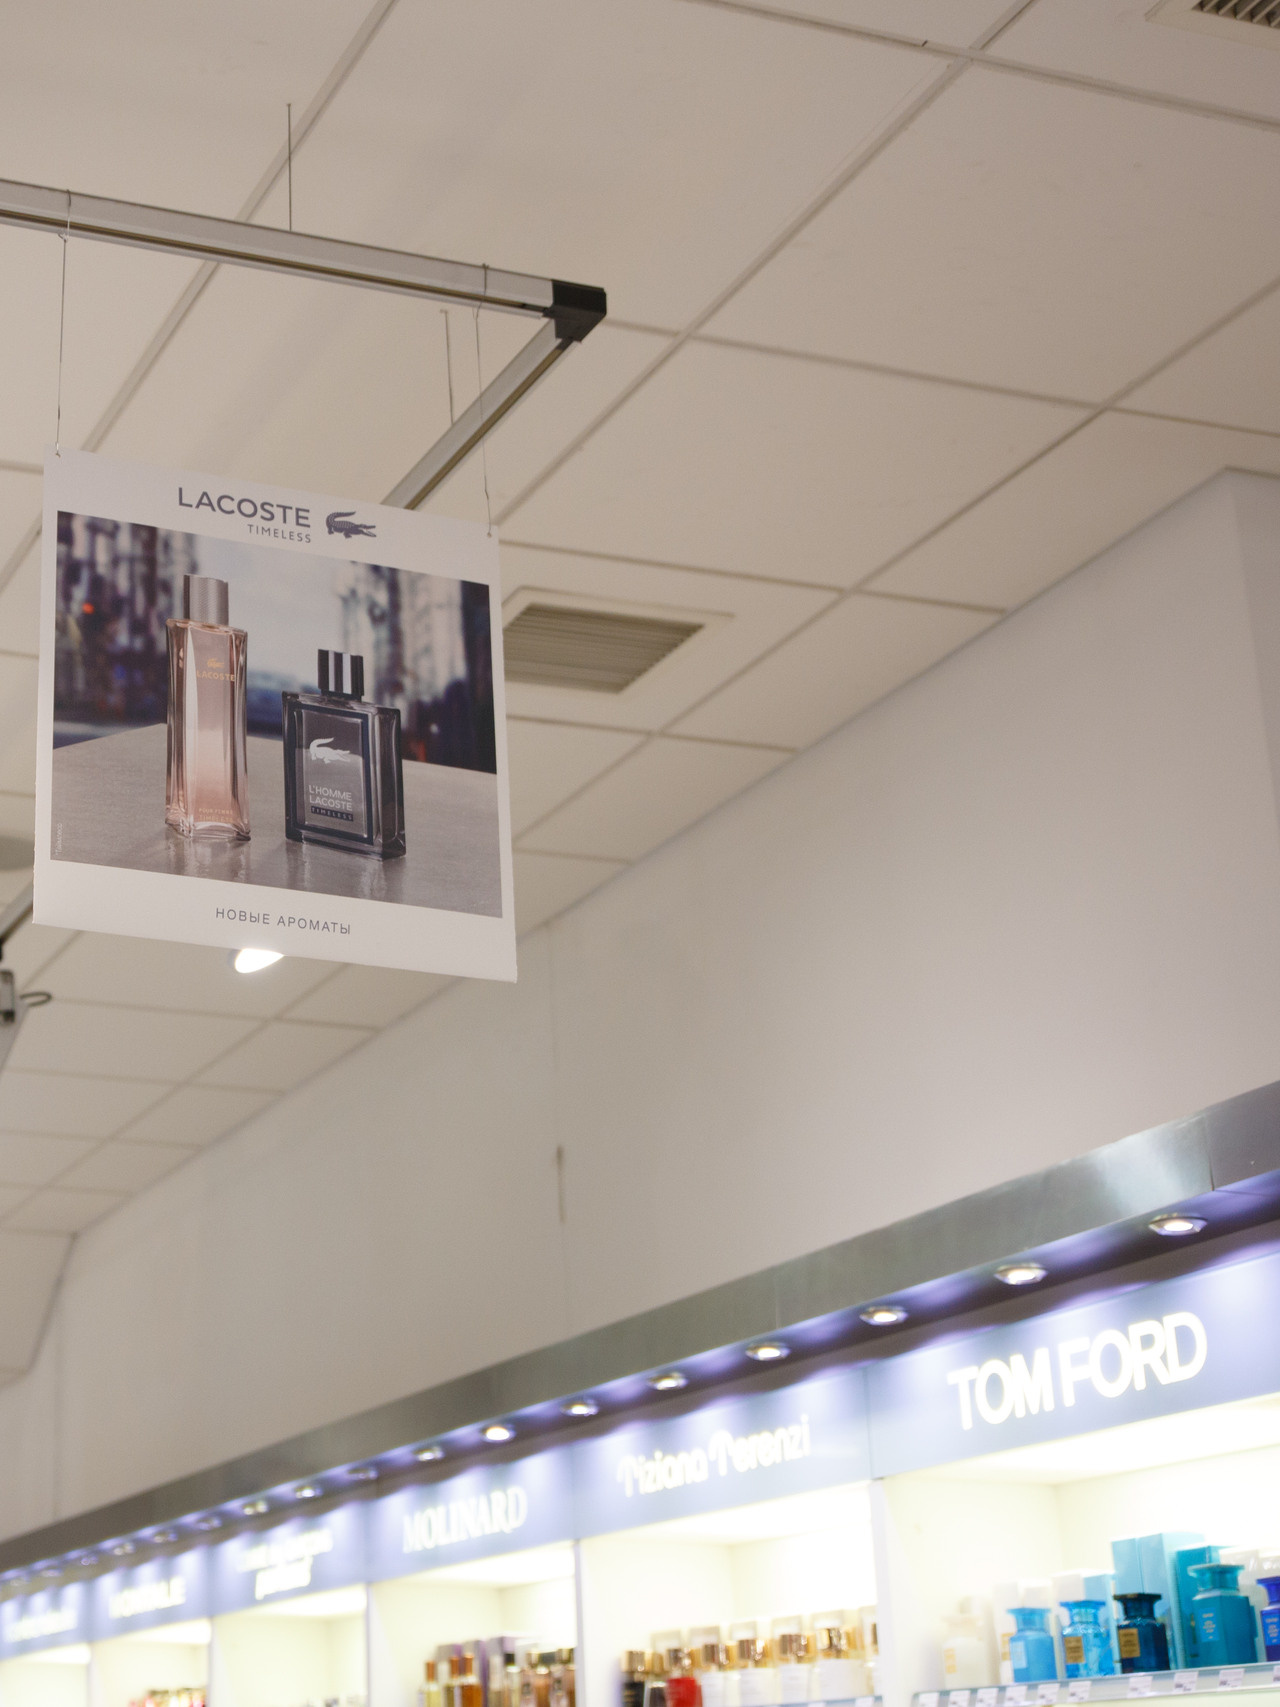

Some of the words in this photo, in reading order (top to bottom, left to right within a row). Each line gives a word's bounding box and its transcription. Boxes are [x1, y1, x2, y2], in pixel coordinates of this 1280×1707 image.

[178, 487, 311, 528] LACOSTE
[247, 523, 311, 544] TIMELESS
[196, 669, 235, 682] LACOSTE
[308, 784, 353, 801] L'HOMME
[309, 795, 353, 812] LACOSTE
[311, 806, 353, 821] TIMELESS
[215, 907, 270, 925] НОВЫЕ
[276, 915, 351, 935] АРОМАТЫ
[946, 1346, 1055, 1432] TOM
[1058, 1311, 1208, 1409] FORD
[616, 1450, 709, 1498] Tiziana
[708, 1413, 811, 1477] Terenzi
[402, 1486, 528, 1553] MOLINARD
